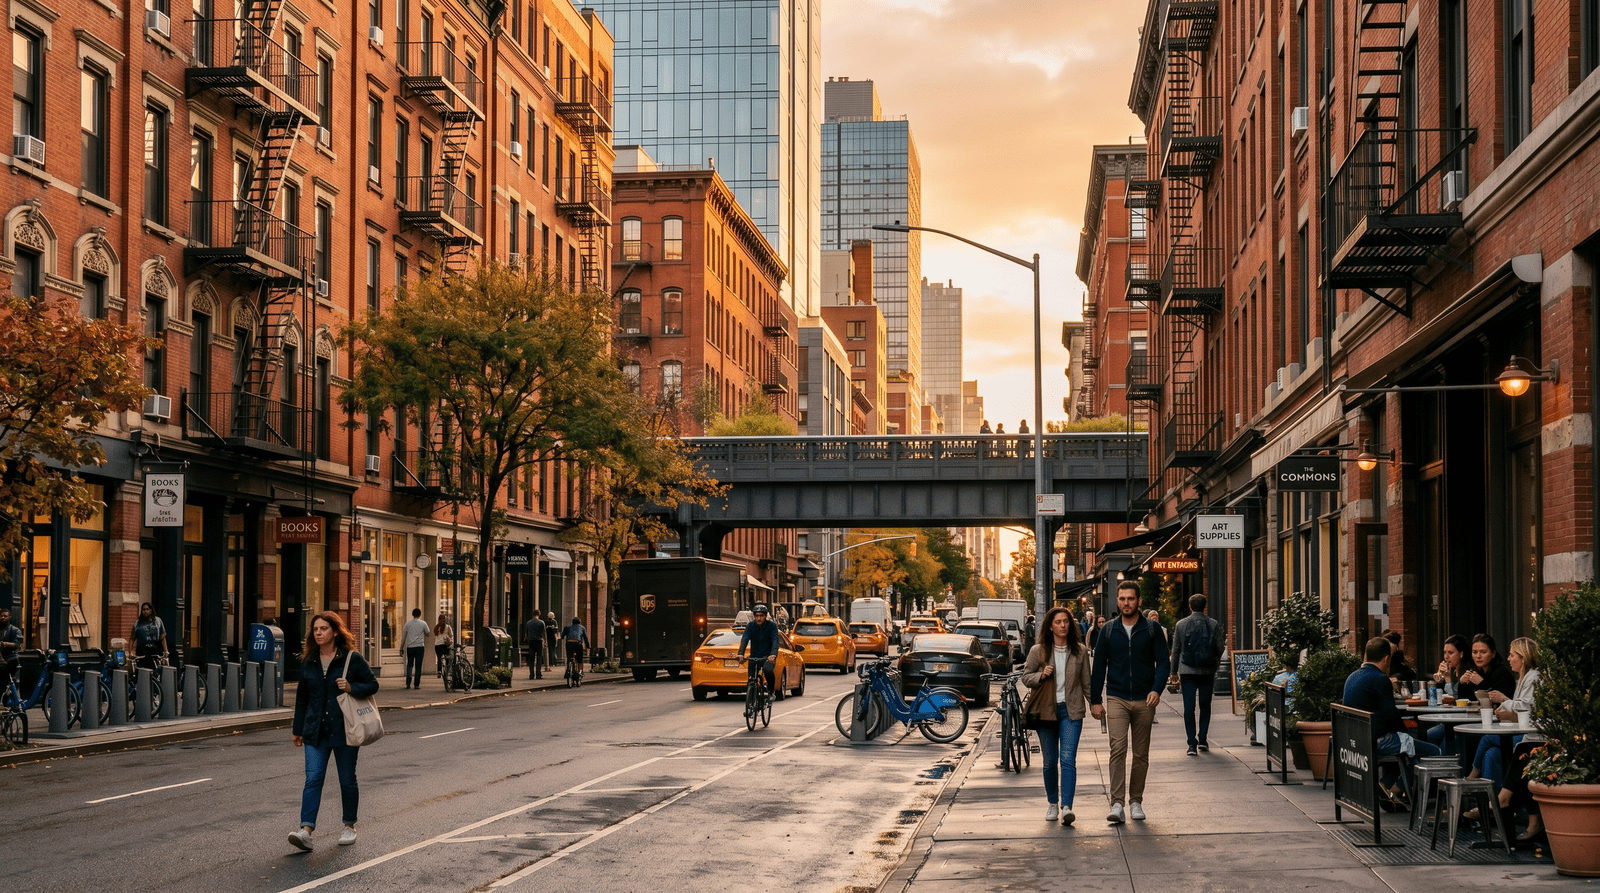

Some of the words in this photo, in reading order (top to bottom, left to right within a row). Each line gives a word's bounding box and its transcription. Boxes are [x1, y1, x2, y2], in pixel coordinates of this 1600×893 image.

[1281, 473, 1336, 481] COMMONS
[151, 479, 179, 487] BOOKS
[281, 522, 319, 532] BOOKS
[1200, 532, 1241, 540] SUPPLIES
[1153, 561, 1167, 569] ART
[641, 599, 655, 611] ups
[1340, 747, 1369, 772] COMMONS
